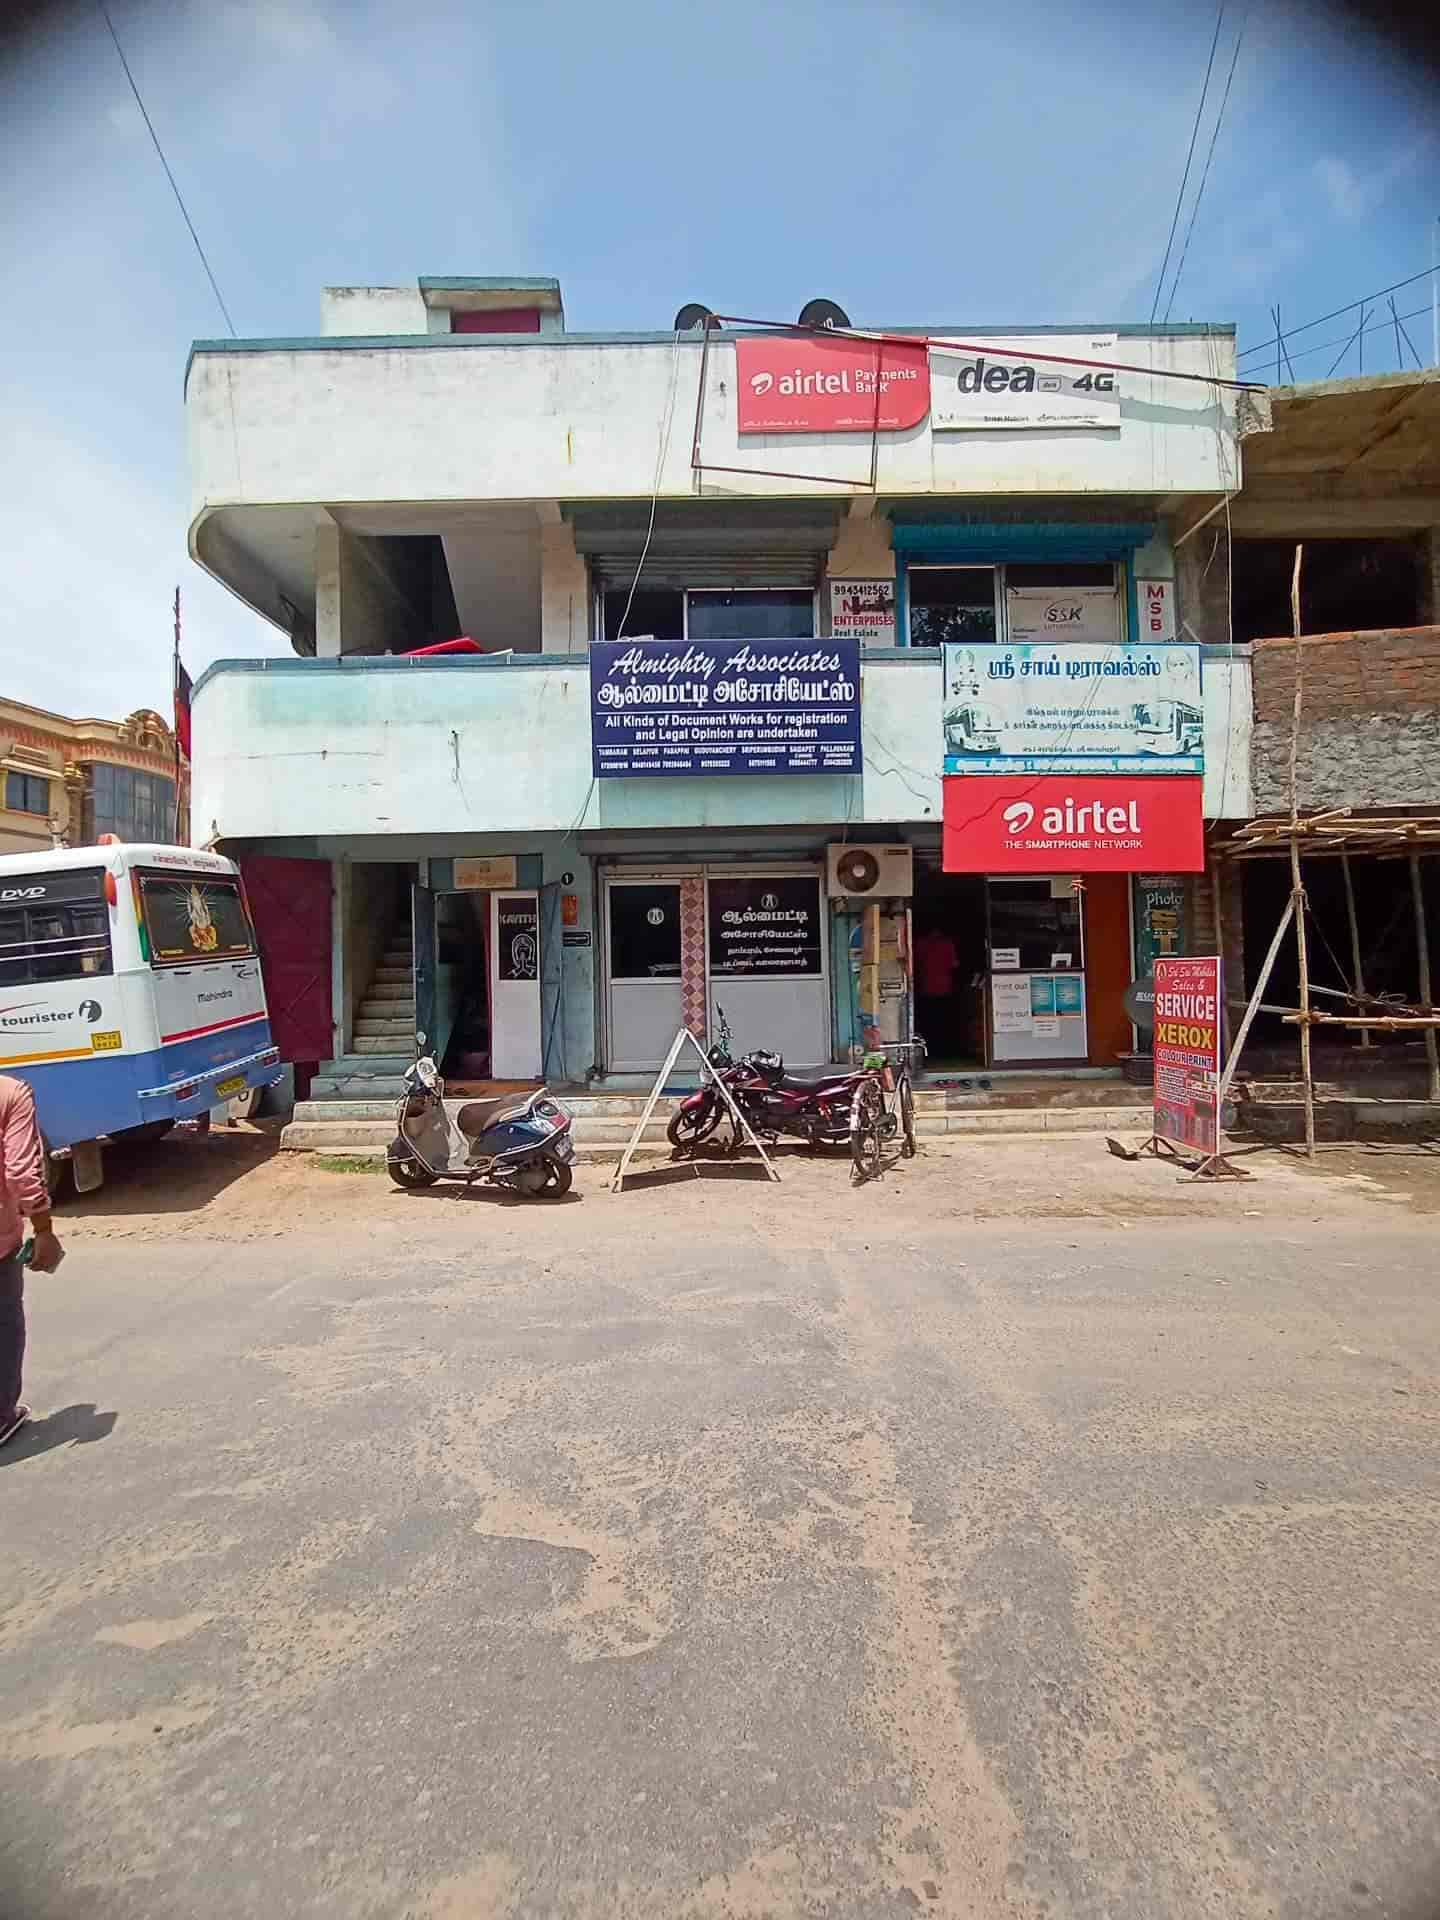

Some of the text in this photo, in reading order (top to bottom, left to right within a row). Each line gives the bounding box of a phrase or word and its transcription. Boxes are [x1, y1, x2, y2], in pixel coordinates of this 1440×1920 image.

[779, 370, 850, 395] airtel
[1072, 373, 1114, 392] 4G
[833, 615, 895, 626] ENTERPRISES
[609, 646, 840, 681] Almighty Associates
[1019, 654, 1060, 677] சாய்
[1065, 654, 1161, 680] டிராவல்ஸ்
[597, 672, 855, 708] ஆல்மைட்டி அசோசியேட்ஸ்
[605, 711, 847, 728] All Kinds of Document Works for registration
[636, 727, 818, 743] and Legal Opinion are undertaken
[1041, 797, 1142, 835] airtel
[1004, 838, 1143, 850] THE SMARTPHONE NETWORK
[1, 886, 47, 900] DVD
[1156, 992, 1215, 1021] SERVICE
[1, 1008, 75, 1028] tourister
[1156, 1022, 1214, 1049] XEROX
